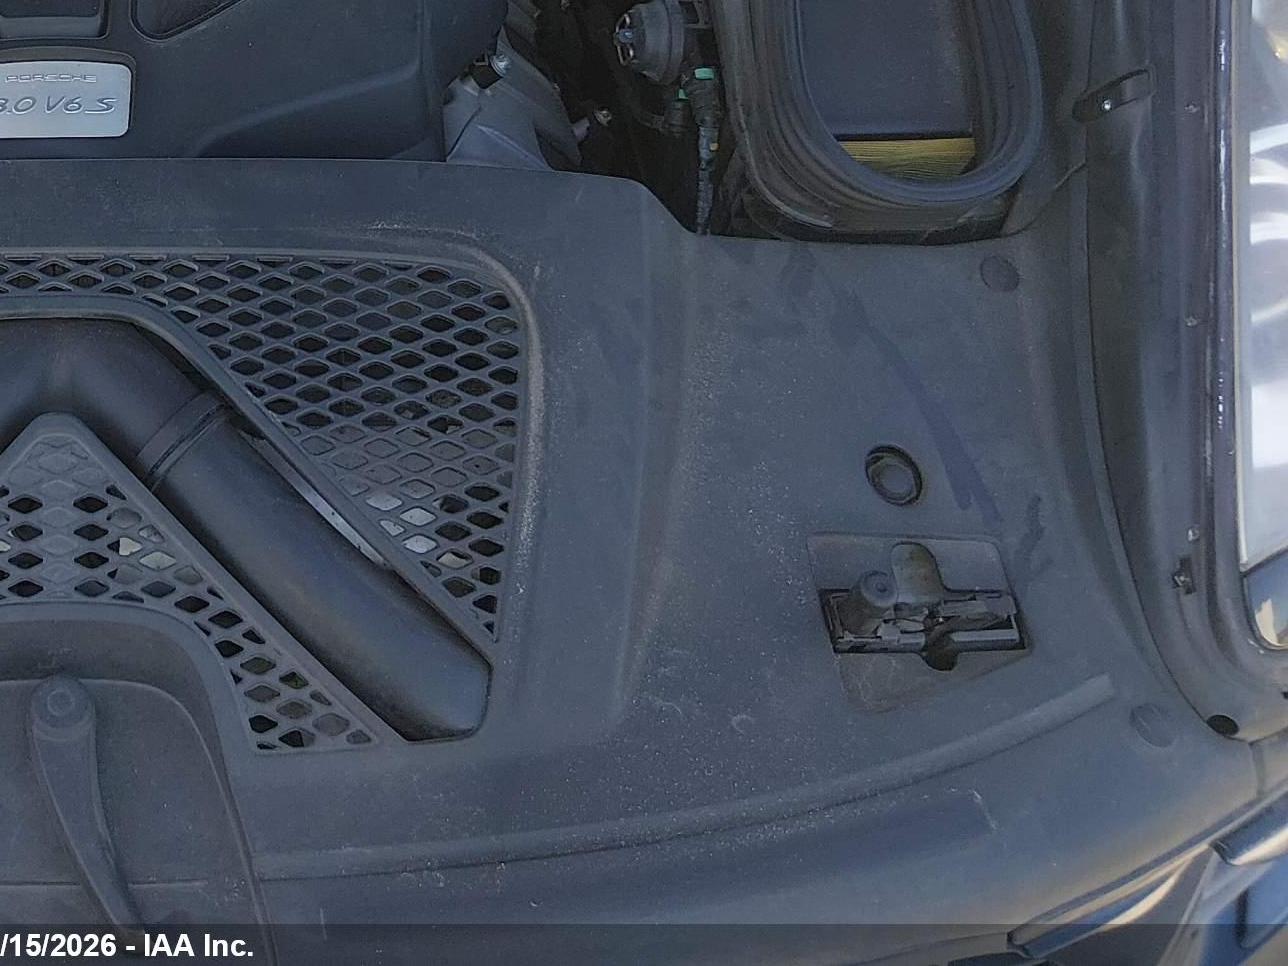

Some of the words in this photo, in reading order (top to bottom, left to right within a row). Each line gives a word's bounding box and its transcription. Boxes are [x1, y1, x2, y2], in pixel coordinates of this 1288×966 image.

[5, 74, 97, 83] PORSCHE
[44, 95, 83, 114] V6
[85, 96, 118, 114] S
